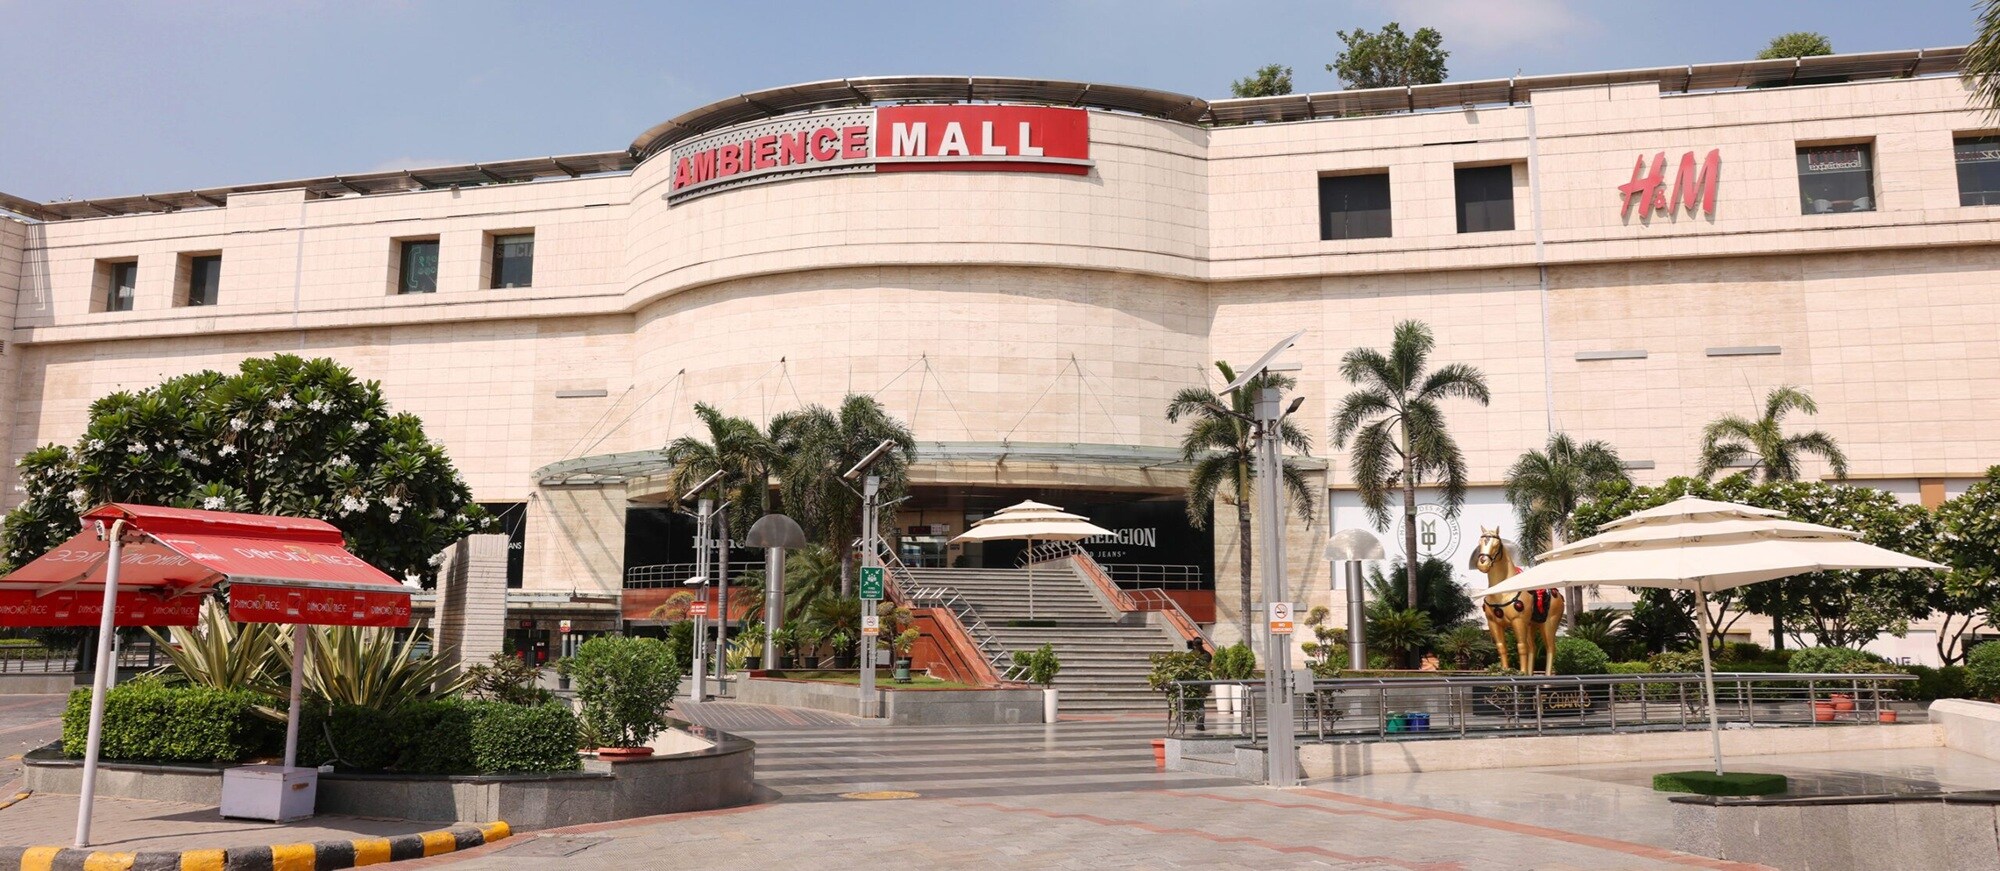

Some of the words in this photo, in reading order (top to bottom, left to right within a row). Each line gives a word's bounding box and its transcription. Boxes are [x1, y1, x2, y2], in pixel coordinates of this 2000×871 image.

[673, 126, 868, 190] AMBIENCE
[891, 121, 1045, 157] MALL
[1618, 148, 1719, 218] H&M
